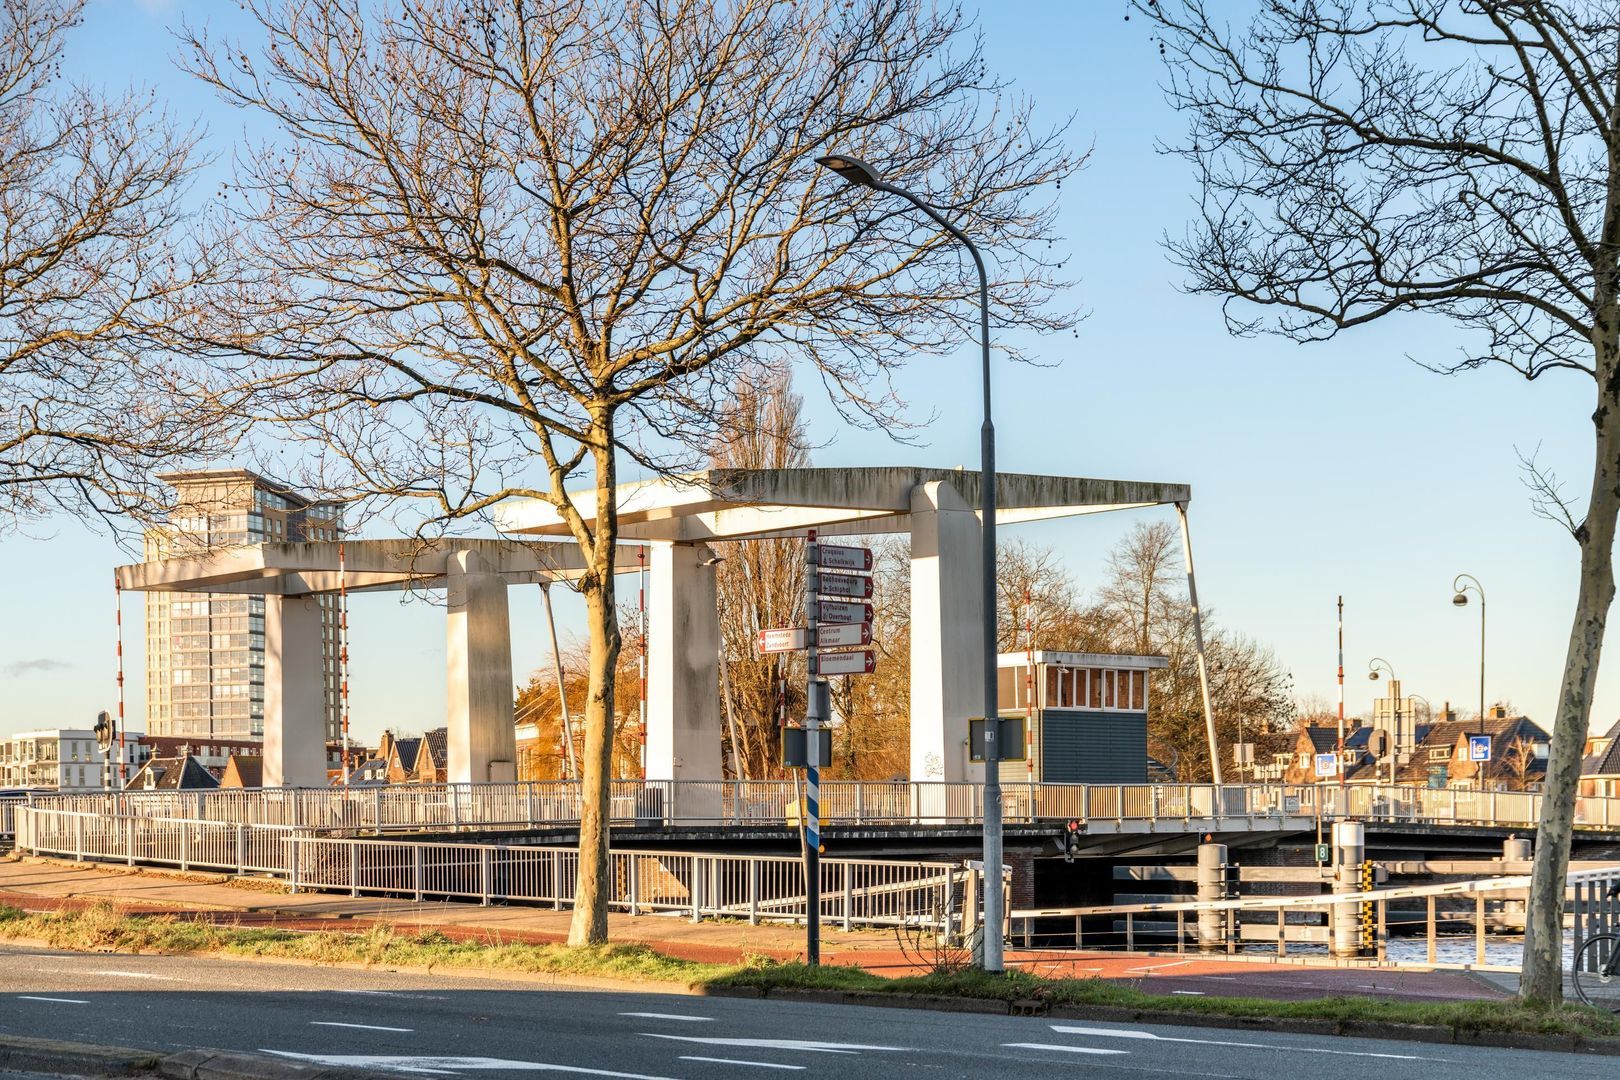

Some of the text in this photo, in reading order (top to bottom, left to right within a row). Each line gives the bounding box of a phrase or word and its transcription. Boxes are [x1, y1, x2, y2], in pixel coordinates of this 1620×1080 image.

[819, 627, 841, 635] Centrum
[821, 653, 854, 662] Bloemendaal
[1319, 847, 1326, 858] 8
